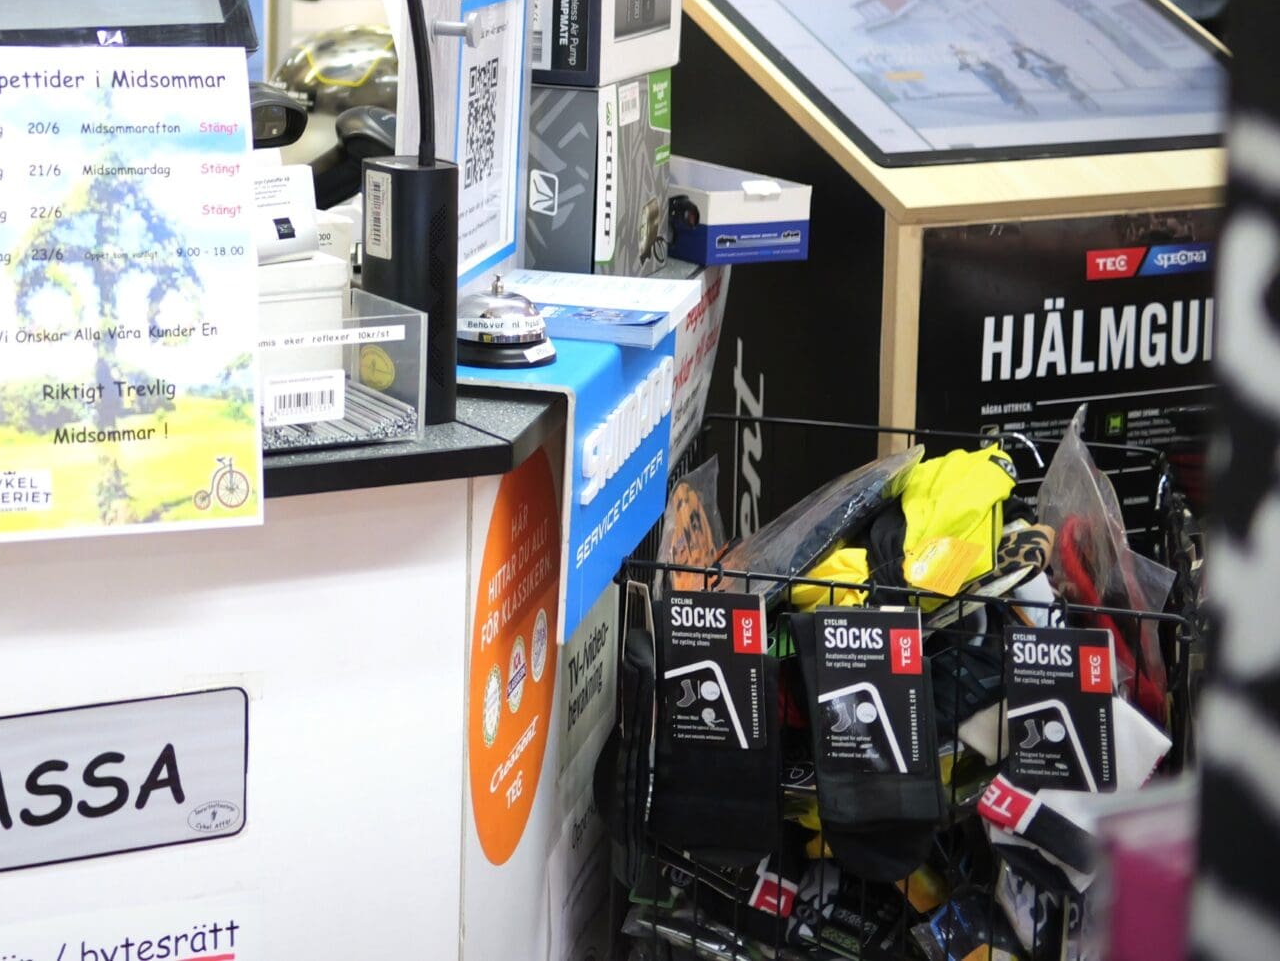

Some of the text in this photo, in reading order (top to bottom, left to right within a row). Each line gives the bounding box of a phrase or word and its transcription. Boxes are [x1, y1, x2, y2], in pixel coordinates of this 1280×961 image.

[570, 23, 579, 37] Air
[569, 38, 579, 66] Pump
[95, 72, 100, 88] i
[111, 71, 226, 89] Midsommar
[28, 123, 60, 135] 20/6
[81, 123, 180, 134] Midsommarafton
[199, 122, 239, 136] Stängt
[29, 165, 61, 176] 21/6
[83, 165, 171, 178] Midsommardag
[201, 163, 241, 177] Stängt
[30, 207, 62, 219] 22/6
[202, 205, 242, 218] Stängt
[31, 249, 64, 261] 23/6
[214, 246, 244, 256] 18.00
[1095, 255, 1127, 271] TEC
[16, 327, 66, 343] Önskar
[74, 328, 101, 340] Alla
[108, 325, 141, 339] Våra
[148, 324, 196, 338] Kunder
[202, 323, 217, 336] En
[358, 330, 389, 339] 10kr/st
[981, 298, 1214, 381] HJÄLMGUI
[43, 380, 176, 403] Riktigt Trevlig
[981, 403, 1032, 415] NÅGRA UTTRYCK:
[53, 423, 168, 445] Midsommar !
[581, 356, 673, 505] SHIMANO
[577, 450, 663, 569] SERVICE CENTER
[511, 503, 528, 541] HÄR
[489, 519, 548, 605] HITTAR DU ALLT
[481, 552, 552, 652] FÖR KLASSIKERN.
[671, 606, 726, 628] SOCKS
[824, 618, 847, 626] CYCLING
[741, 618, 753, 646] TEC
[824, 627, 883, 649] SOCKS
[1013, 633, 1036, 642] CYCLING
[900, 637, 911, 667] TEC
[1013, 642, 1072, 666] SOCKS
[1090, 654, 1101, 685] TEC
[506, 771, 522, 809] TEC
